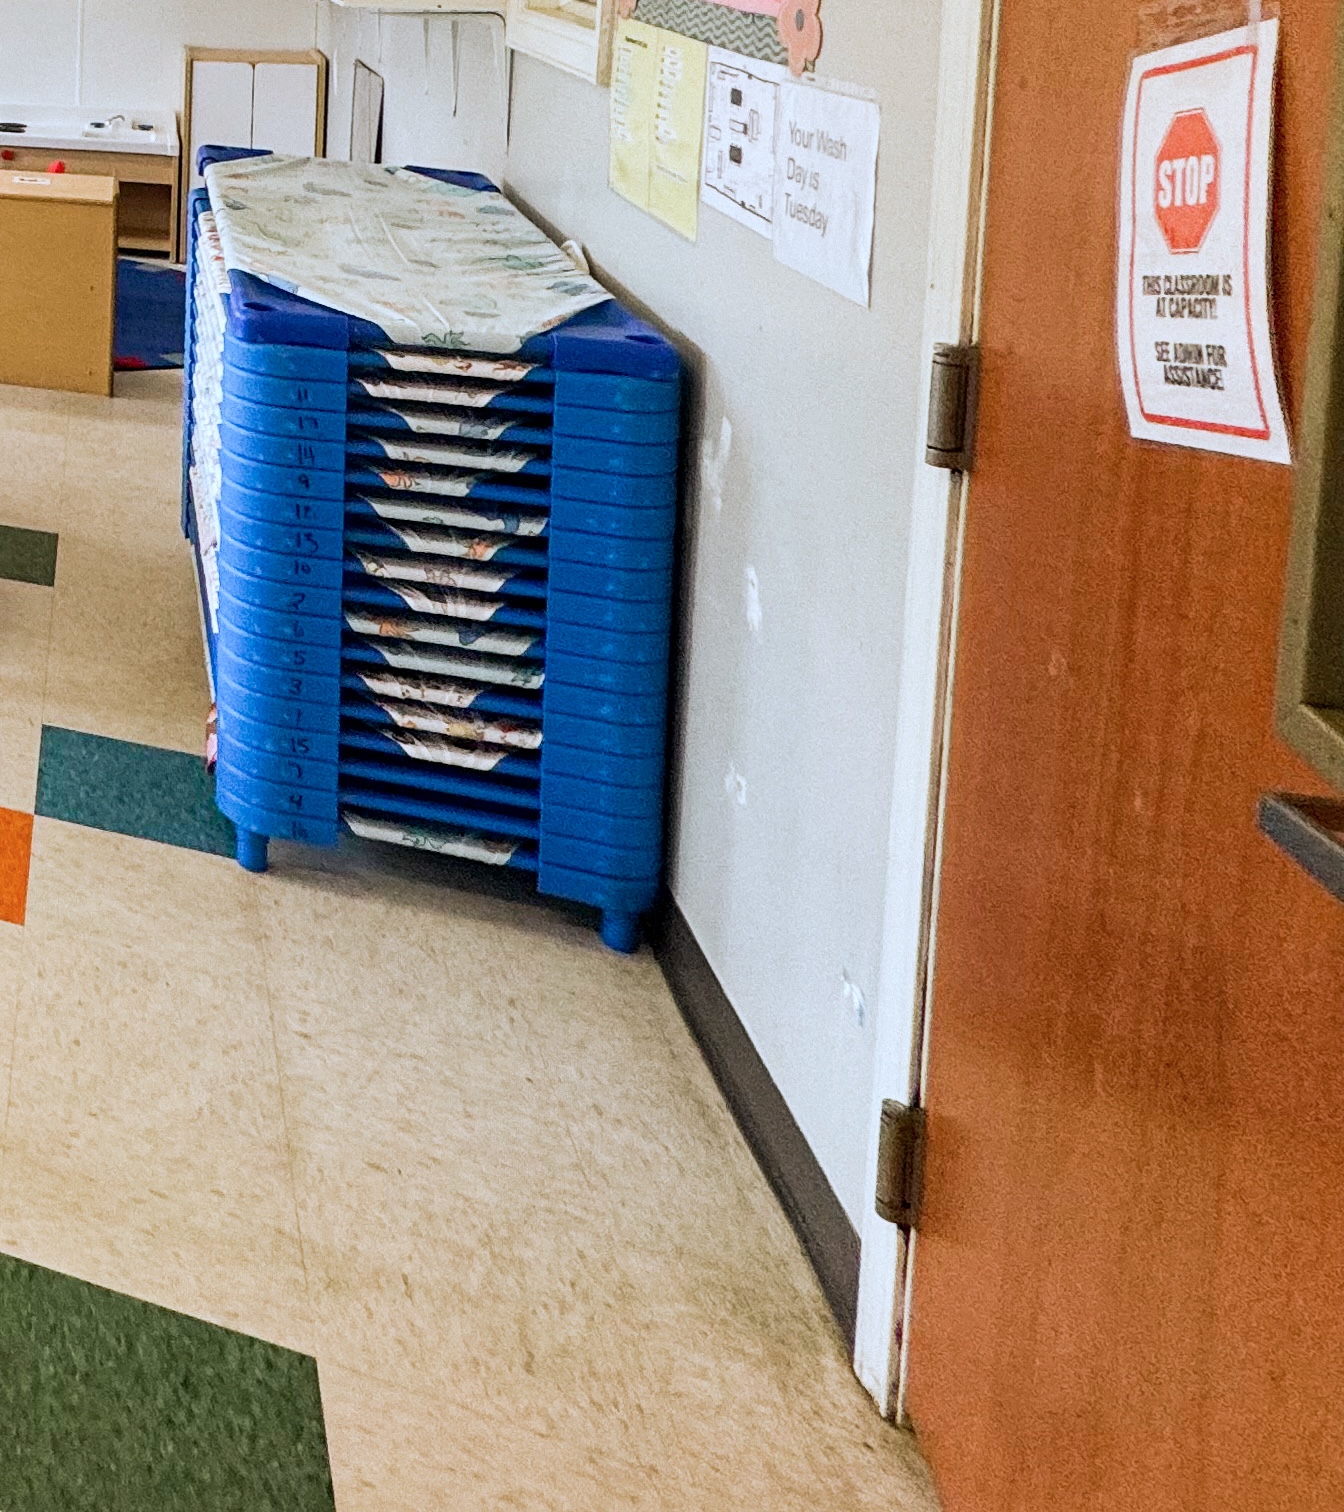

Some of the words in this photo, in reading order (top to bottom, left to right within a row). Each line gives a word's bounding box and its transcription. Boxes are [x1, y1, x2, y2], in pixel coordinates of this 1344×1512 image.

[789, 119, 814, 149] Your
[816, 128, 847, 161] Wash
[787, 157, 808, 190] Day
[809, 170, 820, 190] is
[1158, 153, 1216, 209] STOP
[784, 191, 829, 237] Tuesday
[1142, 275, 1162, 296] THIS
[1163, 274, 1221, 296] CLASSROOM
[1222, 274, 1233, 296] IS
[1156, 297, 1167, 318] AT
[1154, 341, 1171, 363] SEE
[1173, 342, 1204, 365] ADMIN
[1206, 344, 1228, 368] FOR
[298, 473, 310, 489] 9
[294, 559, 312, 576] 10
[293, 592, 306, 611] 2
[294, 649, 307, 666] 5
[289, 678, 303, 696] 3
[290, 738, 310, 754] 15
